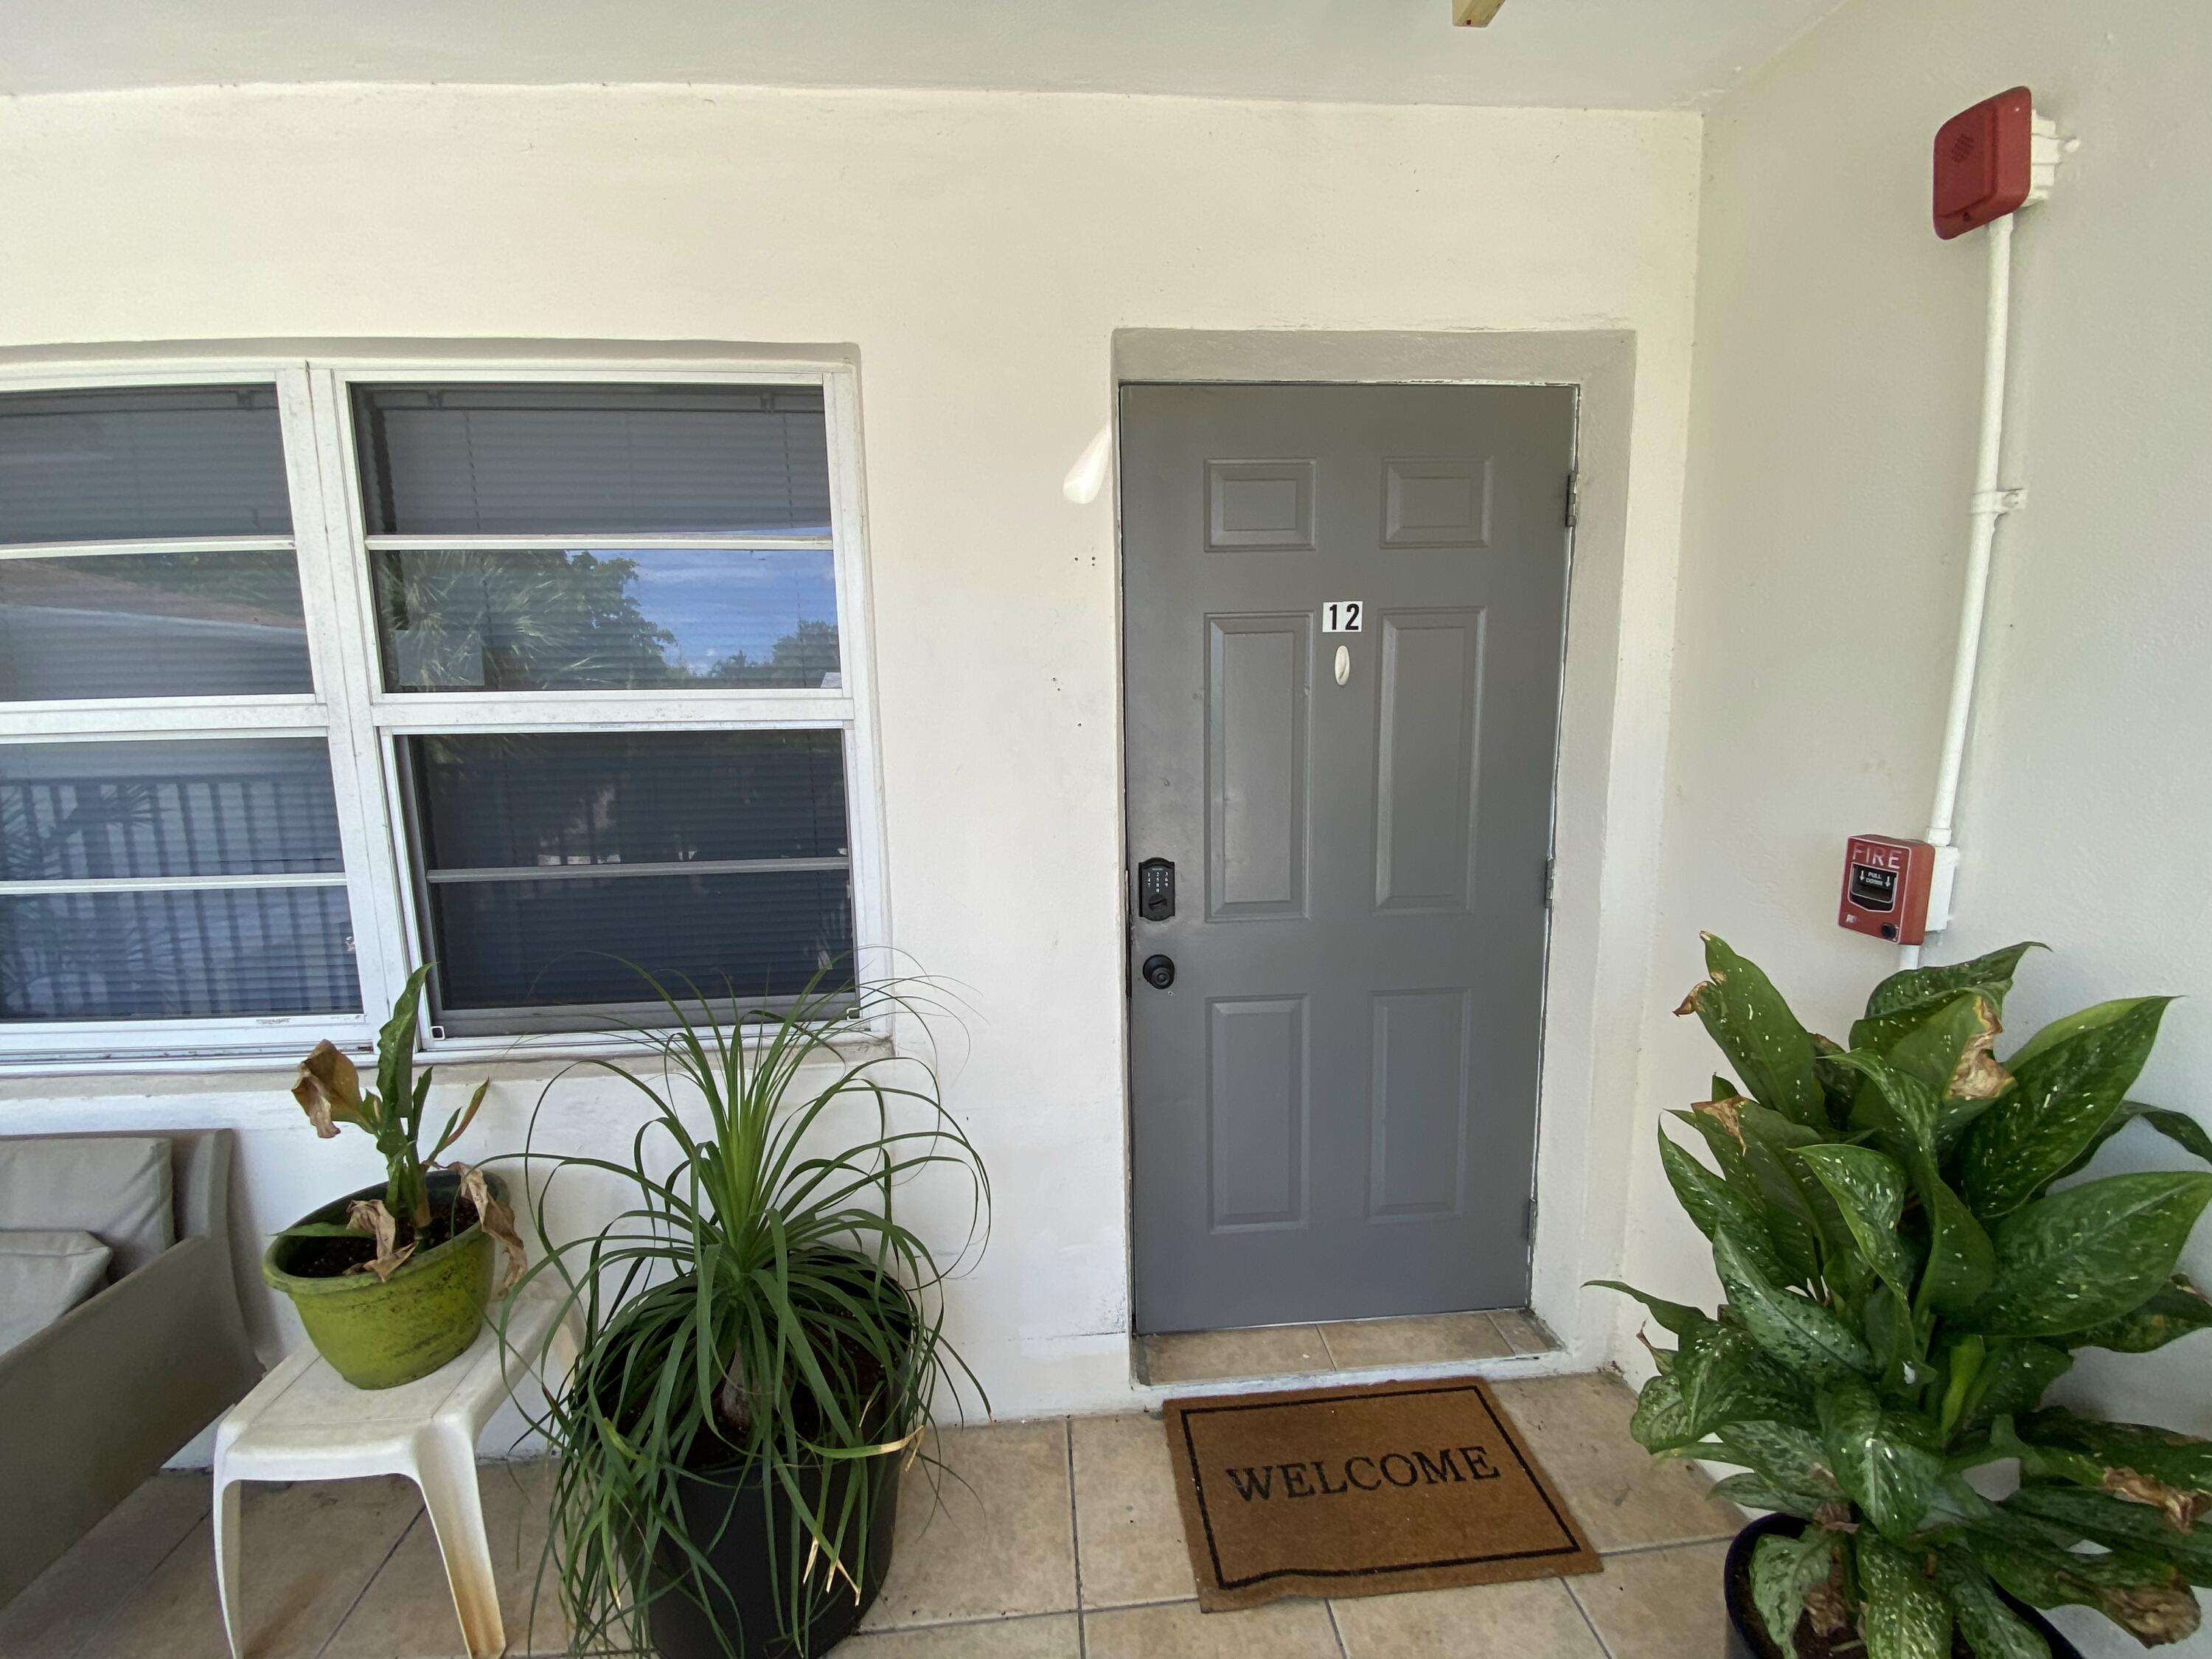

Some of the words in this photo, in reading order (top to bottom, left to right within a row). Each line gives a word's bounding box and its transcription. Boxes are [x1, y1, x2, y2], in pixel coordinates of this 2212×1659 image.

[1329, 603, 1360, 630] 12
[1852, 842, 1902, 869] FIRE
[1865, 877, 1883, 886] DOWN
[1868, 872, 1882, 880] PULL
[1226, 1445, 1500, 1502] WELCOME
